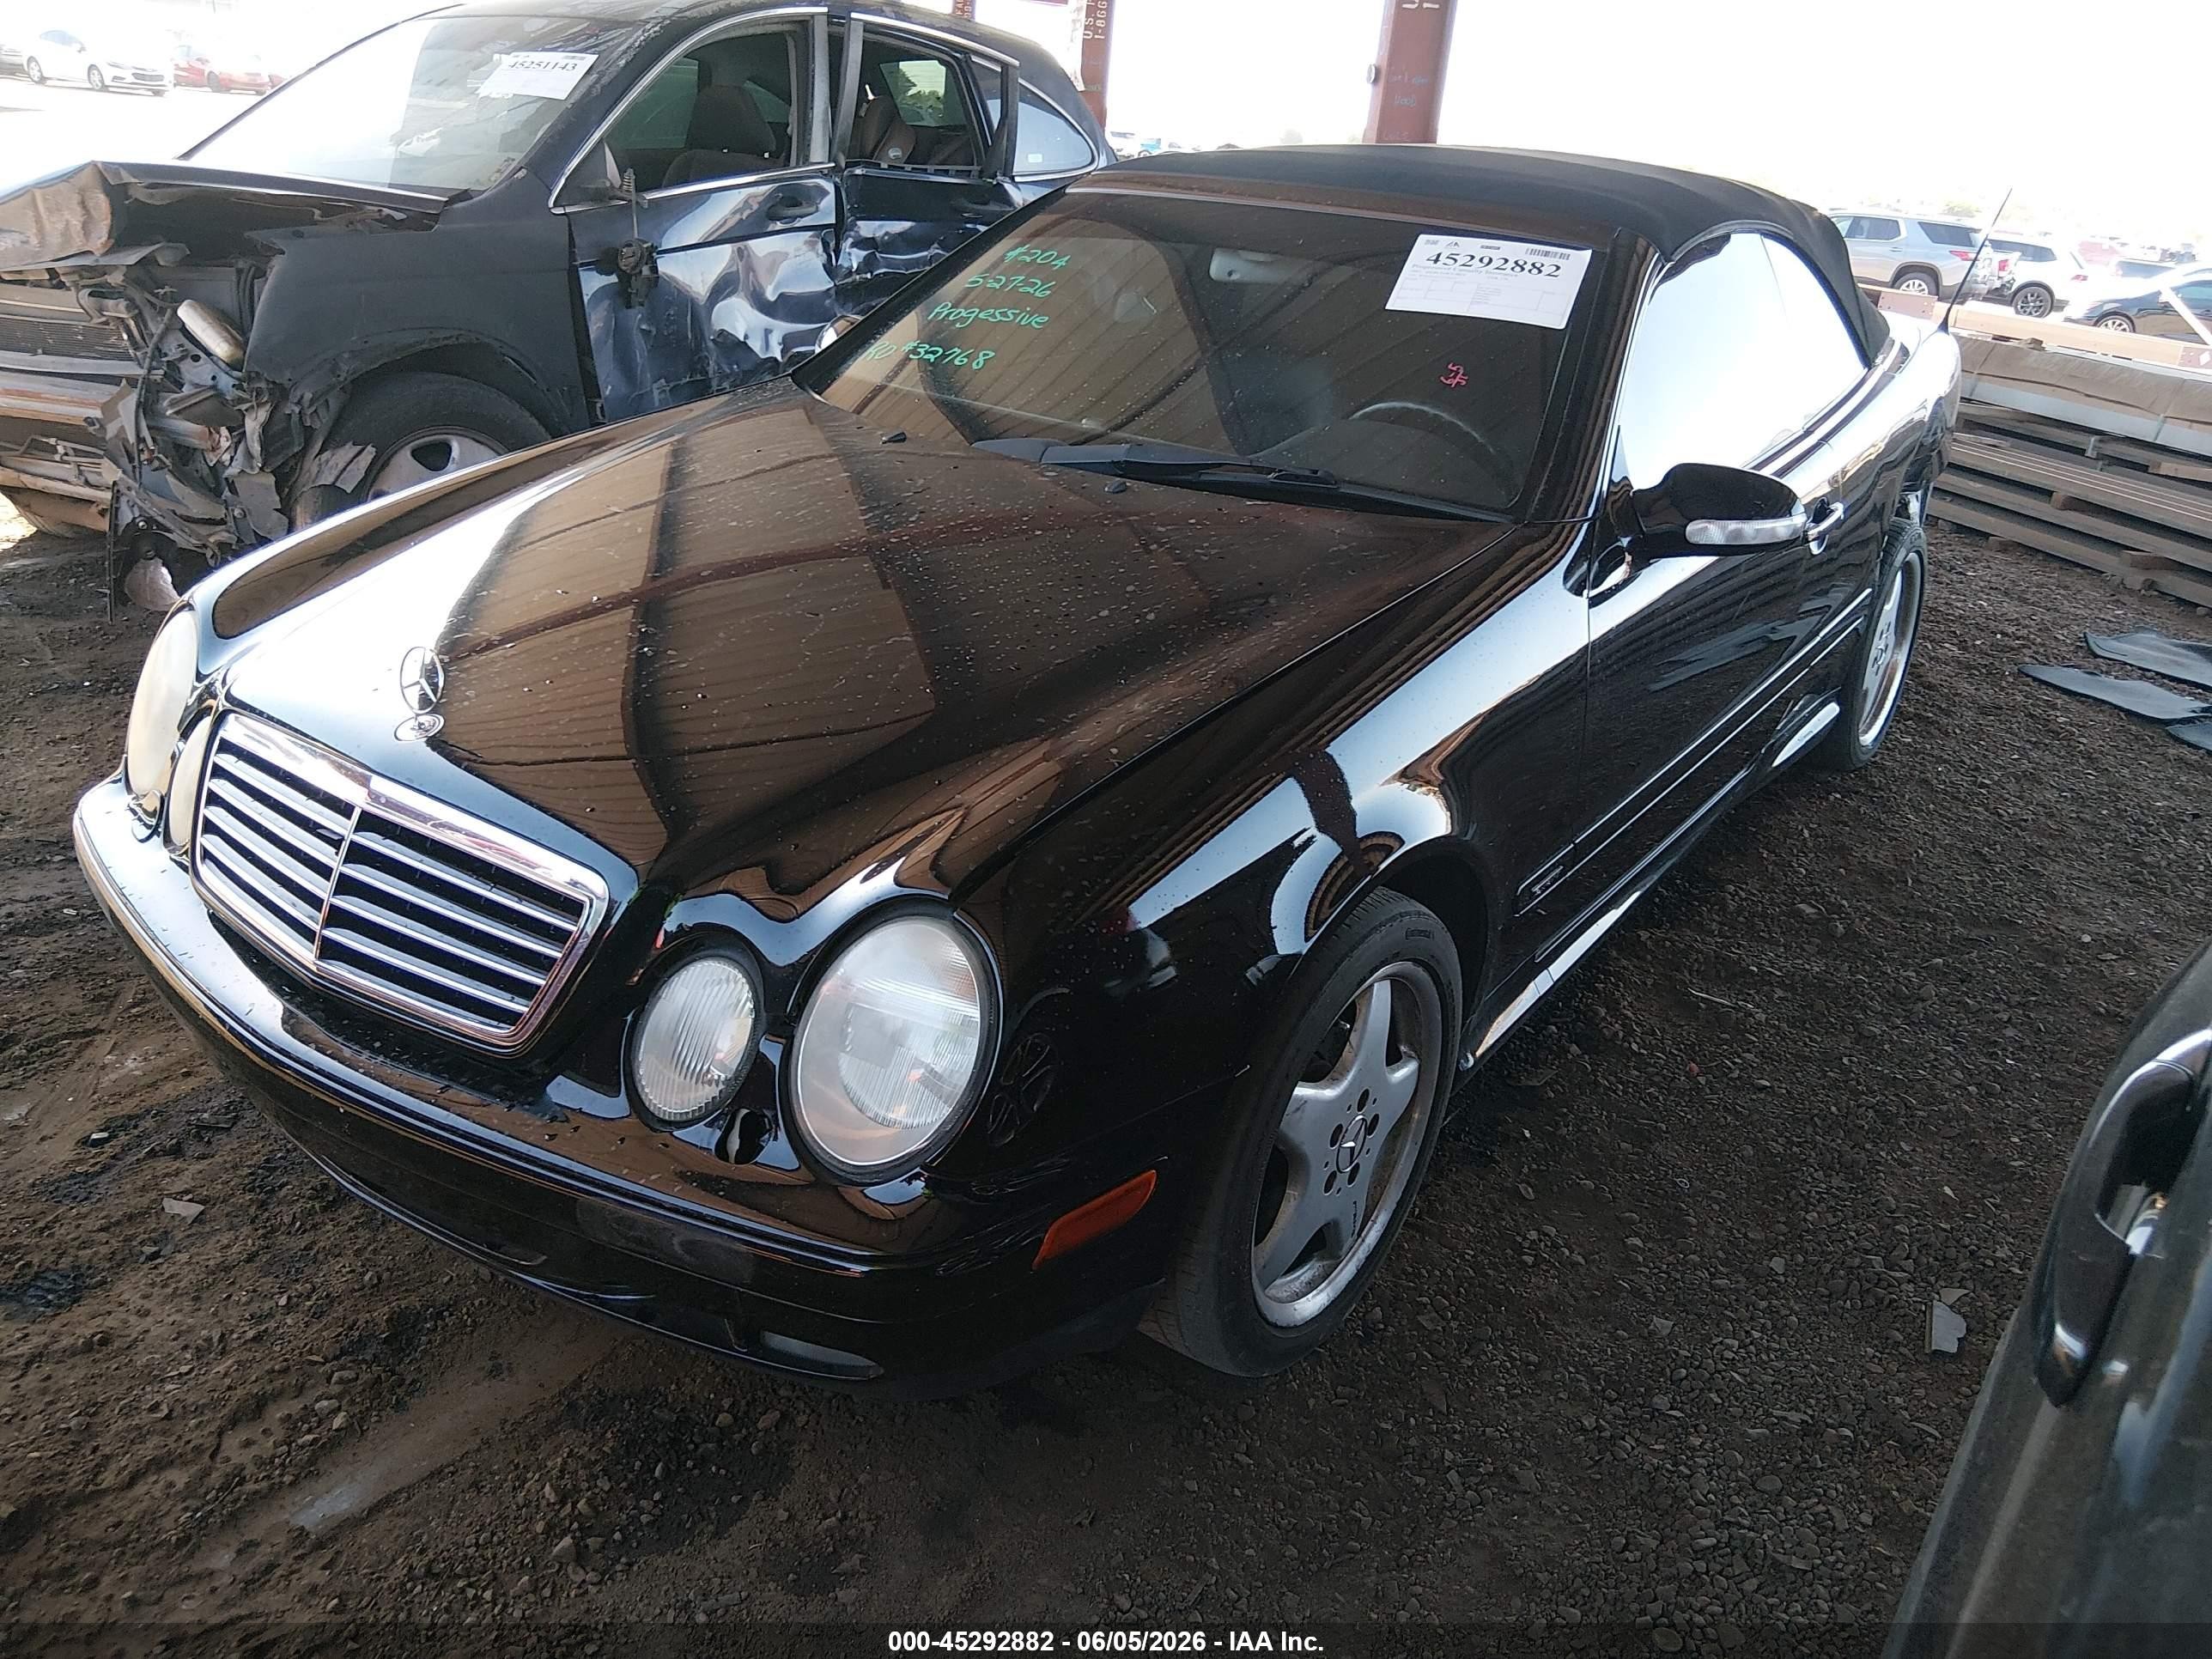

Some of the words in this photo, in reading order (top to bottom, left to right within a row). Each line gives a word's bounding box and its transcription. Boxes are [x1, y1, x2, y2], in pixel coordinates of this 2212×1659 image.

[508, 60, 578, 71] 45251143
[1003, 244, 1071, 270] #204
[1426, 252, 1561, 278] 45292882
[964, 274, 1056, 298] 5-27-26
[927, 302, 1049, 329] Progessive
